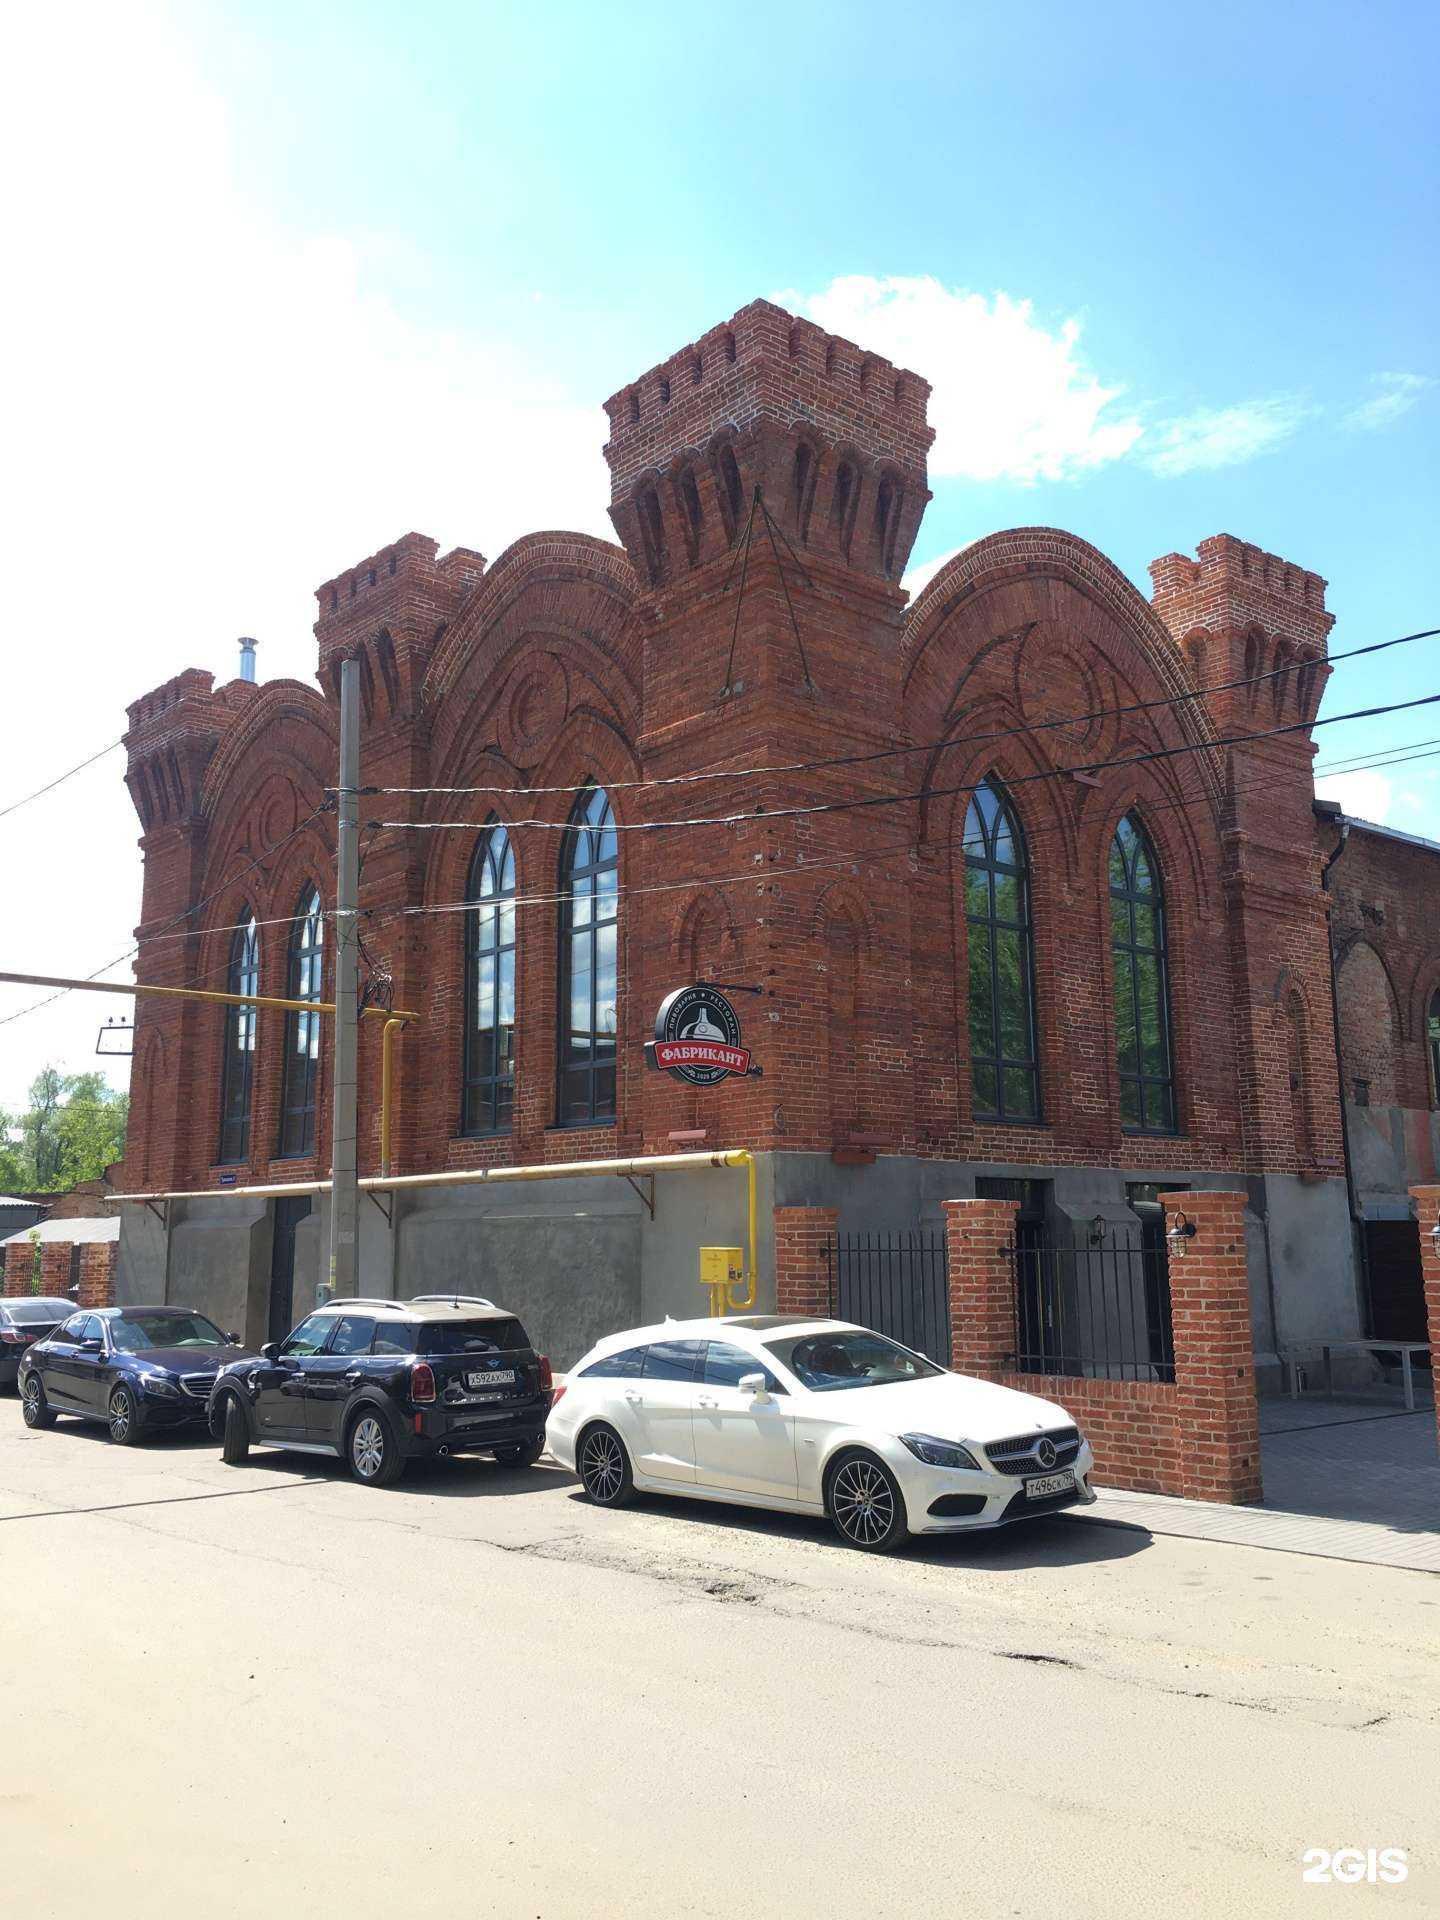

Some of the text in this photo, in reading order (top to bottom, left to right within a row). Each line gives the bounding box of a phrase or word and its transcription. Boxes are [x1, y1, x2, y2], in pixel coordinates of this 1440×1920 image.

[669, 992, 737, 1034] ПИВОВАРНЯ РЕСТОРАН
[661, 1047, 744, 1066] ФАБРИКАНТ
